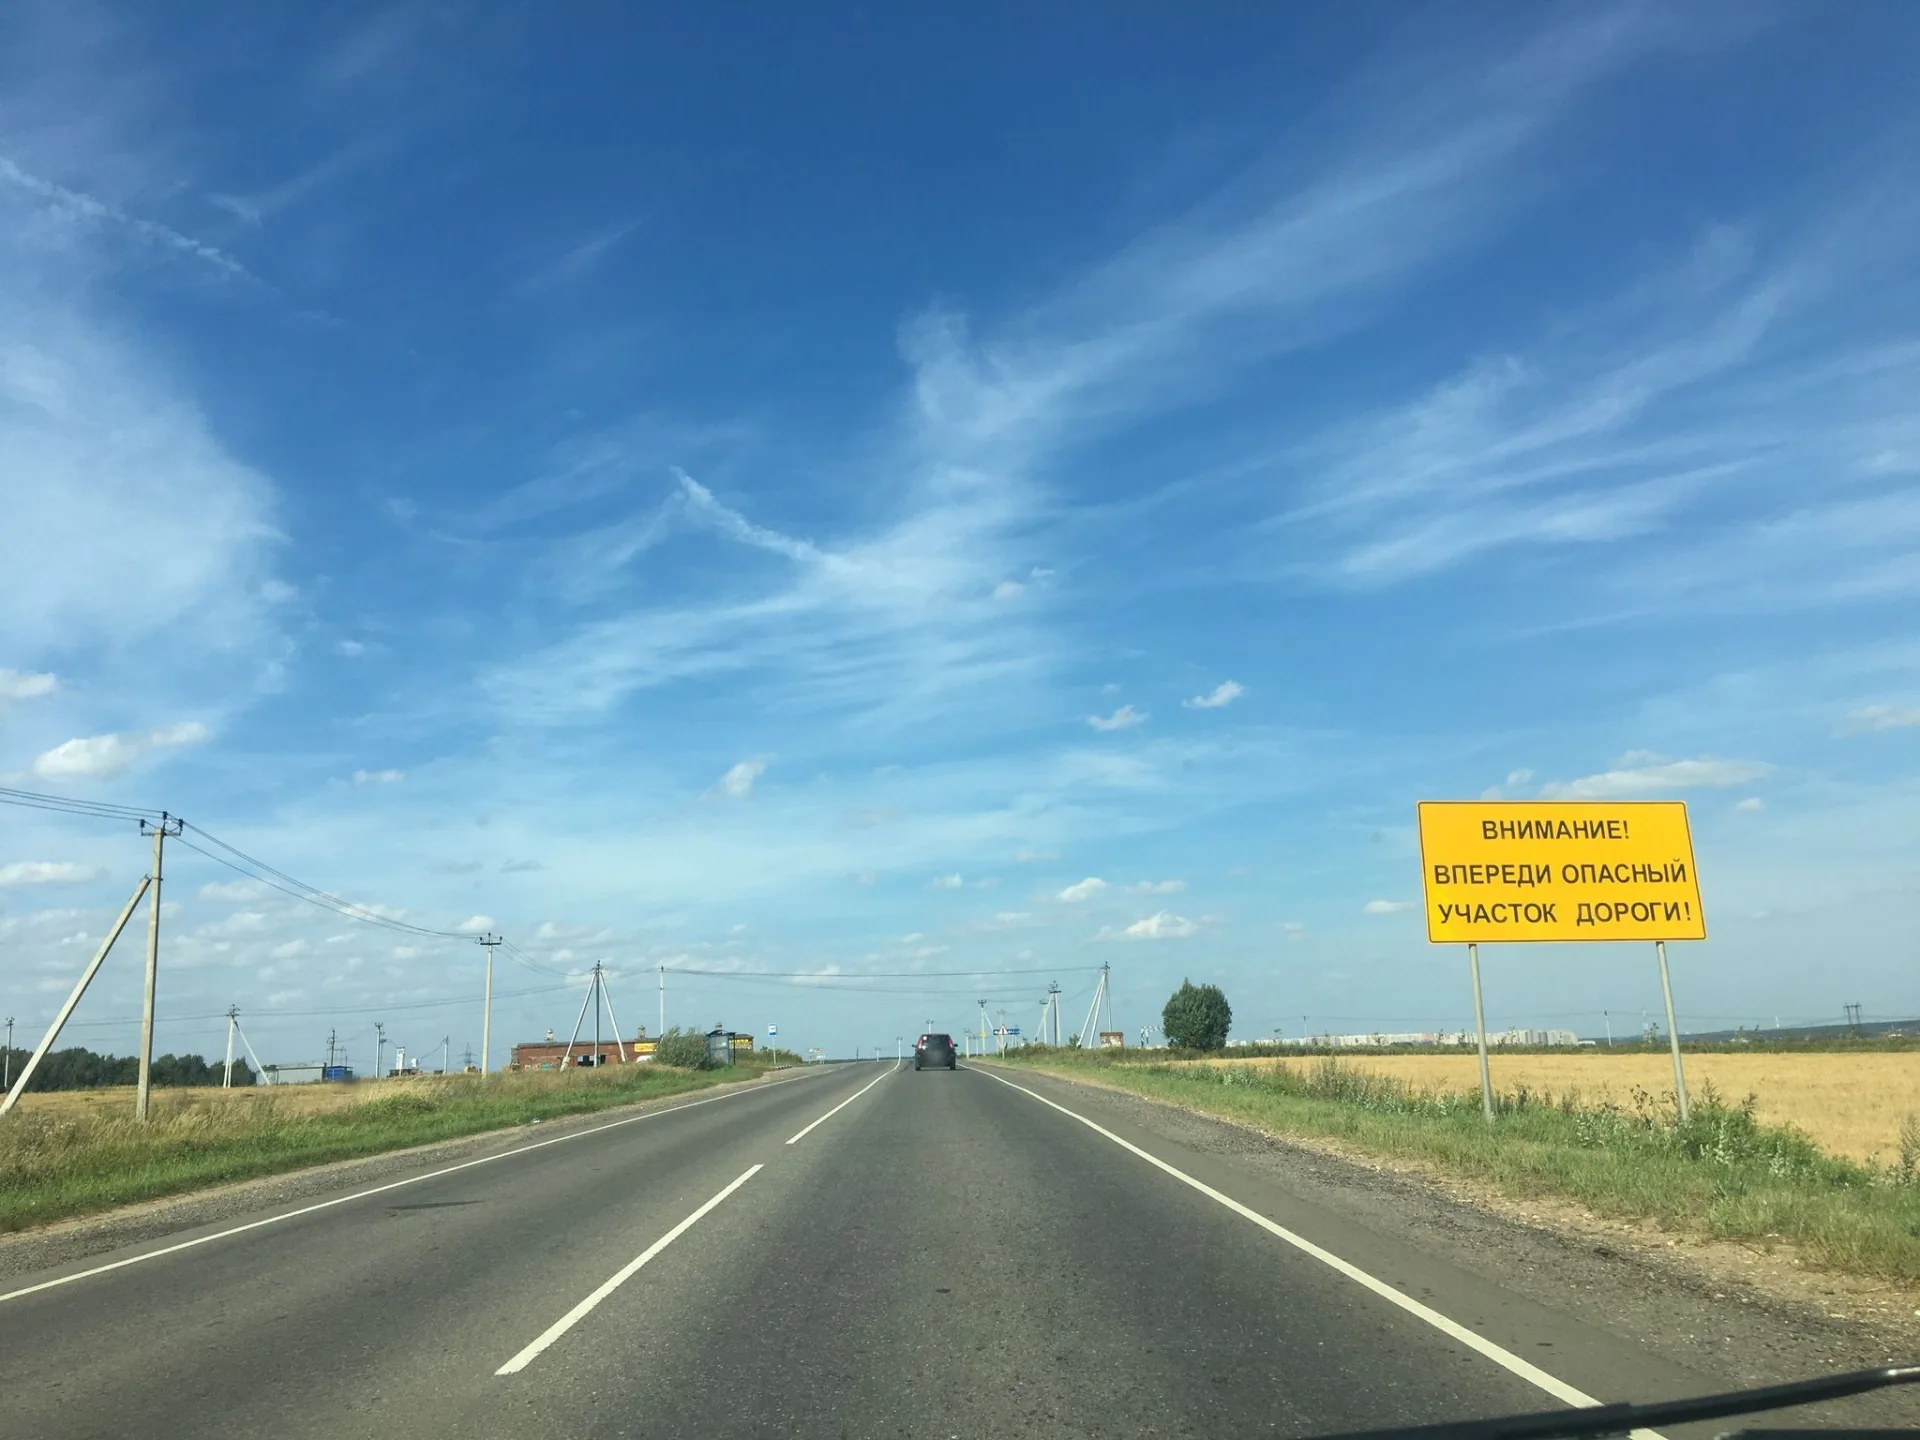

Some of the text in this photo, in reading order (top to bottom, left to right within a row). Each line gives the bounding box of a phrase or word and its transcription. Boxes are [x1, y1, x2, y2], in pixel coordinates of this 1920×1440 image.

[1482, 820, 1630, 839] ВНИМАНИЕ!
[1434, 858, 1687, 888] ВПЕРЕДИ ОПАСНЫЙ
[1438, 902, 1691, 926] УЧАСТОК ДОРОГИ!
